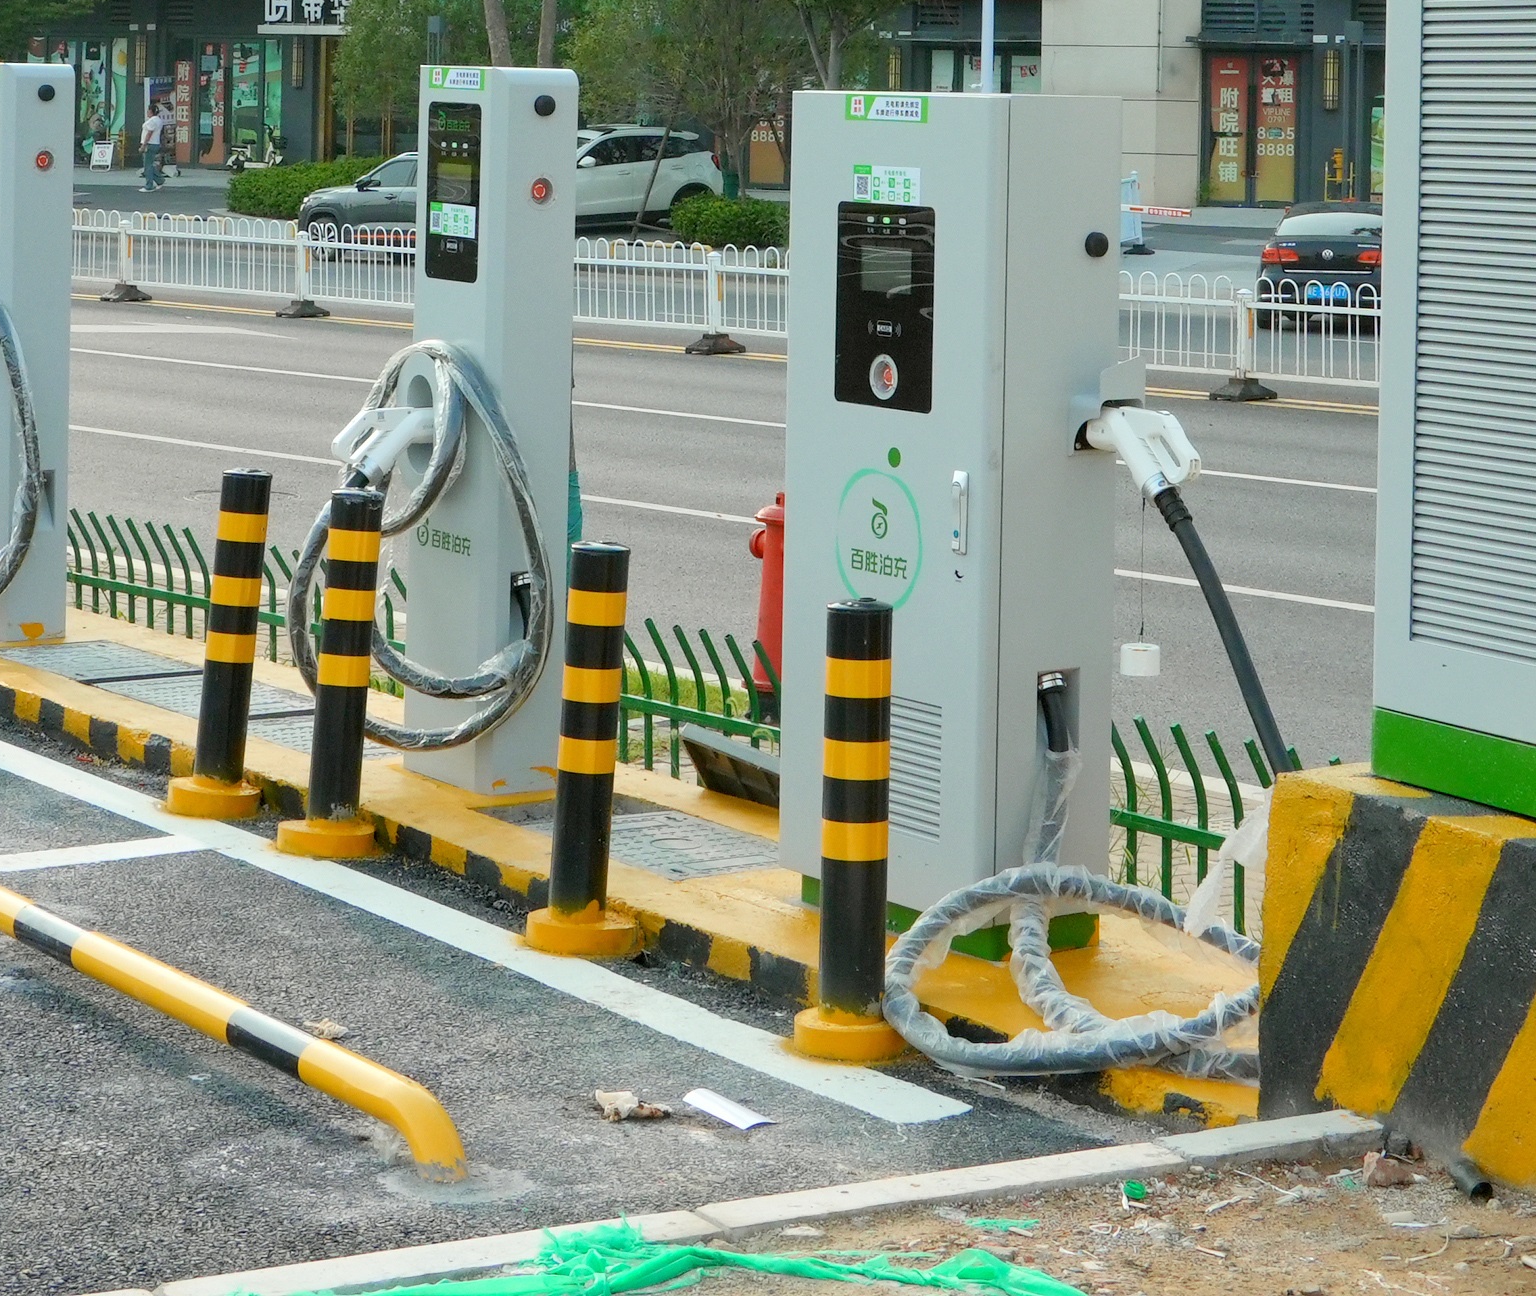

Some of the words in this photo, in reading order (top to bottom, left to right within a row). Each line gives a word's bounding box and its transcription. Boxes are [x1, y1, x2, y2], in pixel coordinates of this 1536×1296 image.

[1256, 143, 1295, 157] 8888
[432, 528, 471, 557] 百胜泊充
[851, 548, 907, 580] 百胜泊充
